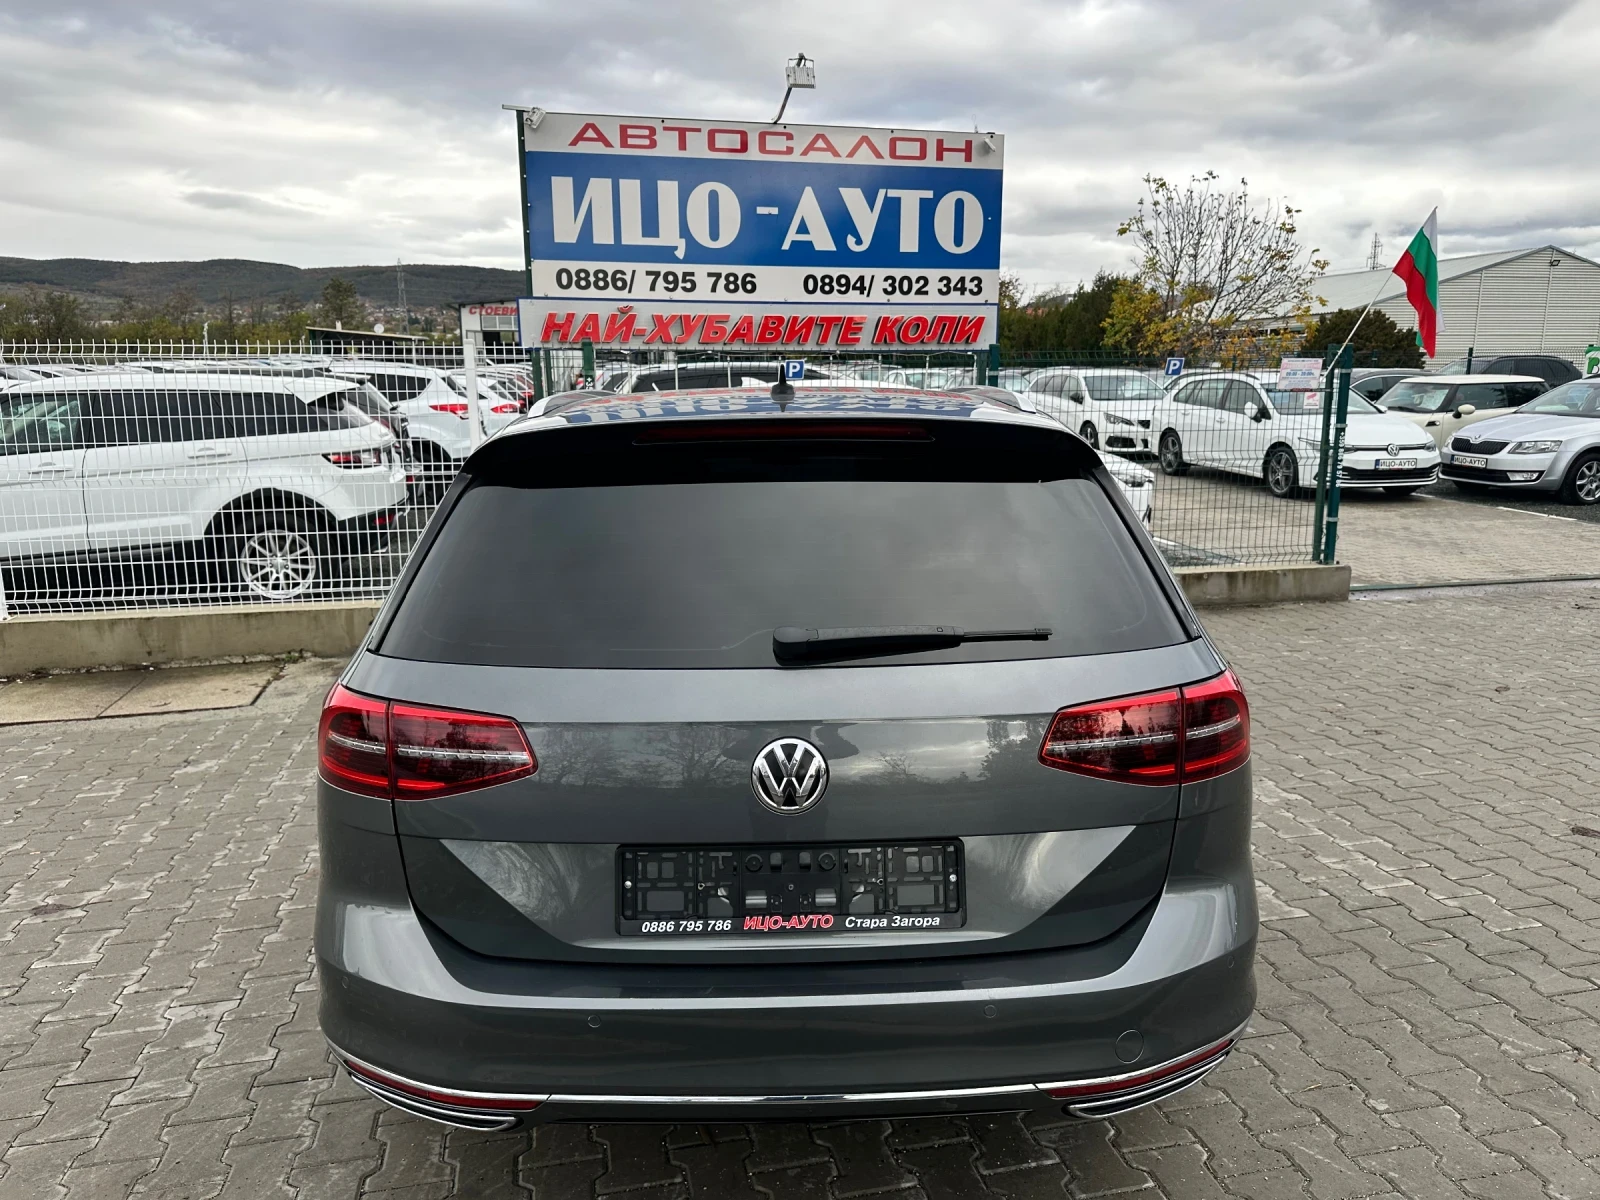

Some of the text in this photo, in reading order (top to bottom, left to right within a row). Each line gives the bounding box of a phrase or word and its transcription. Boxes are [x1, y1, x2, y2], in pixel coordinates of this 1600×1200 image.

[568, 122, 973, 163] АВТОСАЛОН
[555, 267, 757, 294] 0886/ 795 786
[802, 273, 983, 297] 0894/ 302 343
[539, 304, 986, 346] НАЙ-ХУБАВИТЕ КОЛИ
[788, 362, 800, 377] P
[641, 914, 940, 933] 0886 795 786 ИЦО-АУТО Стара Загора
